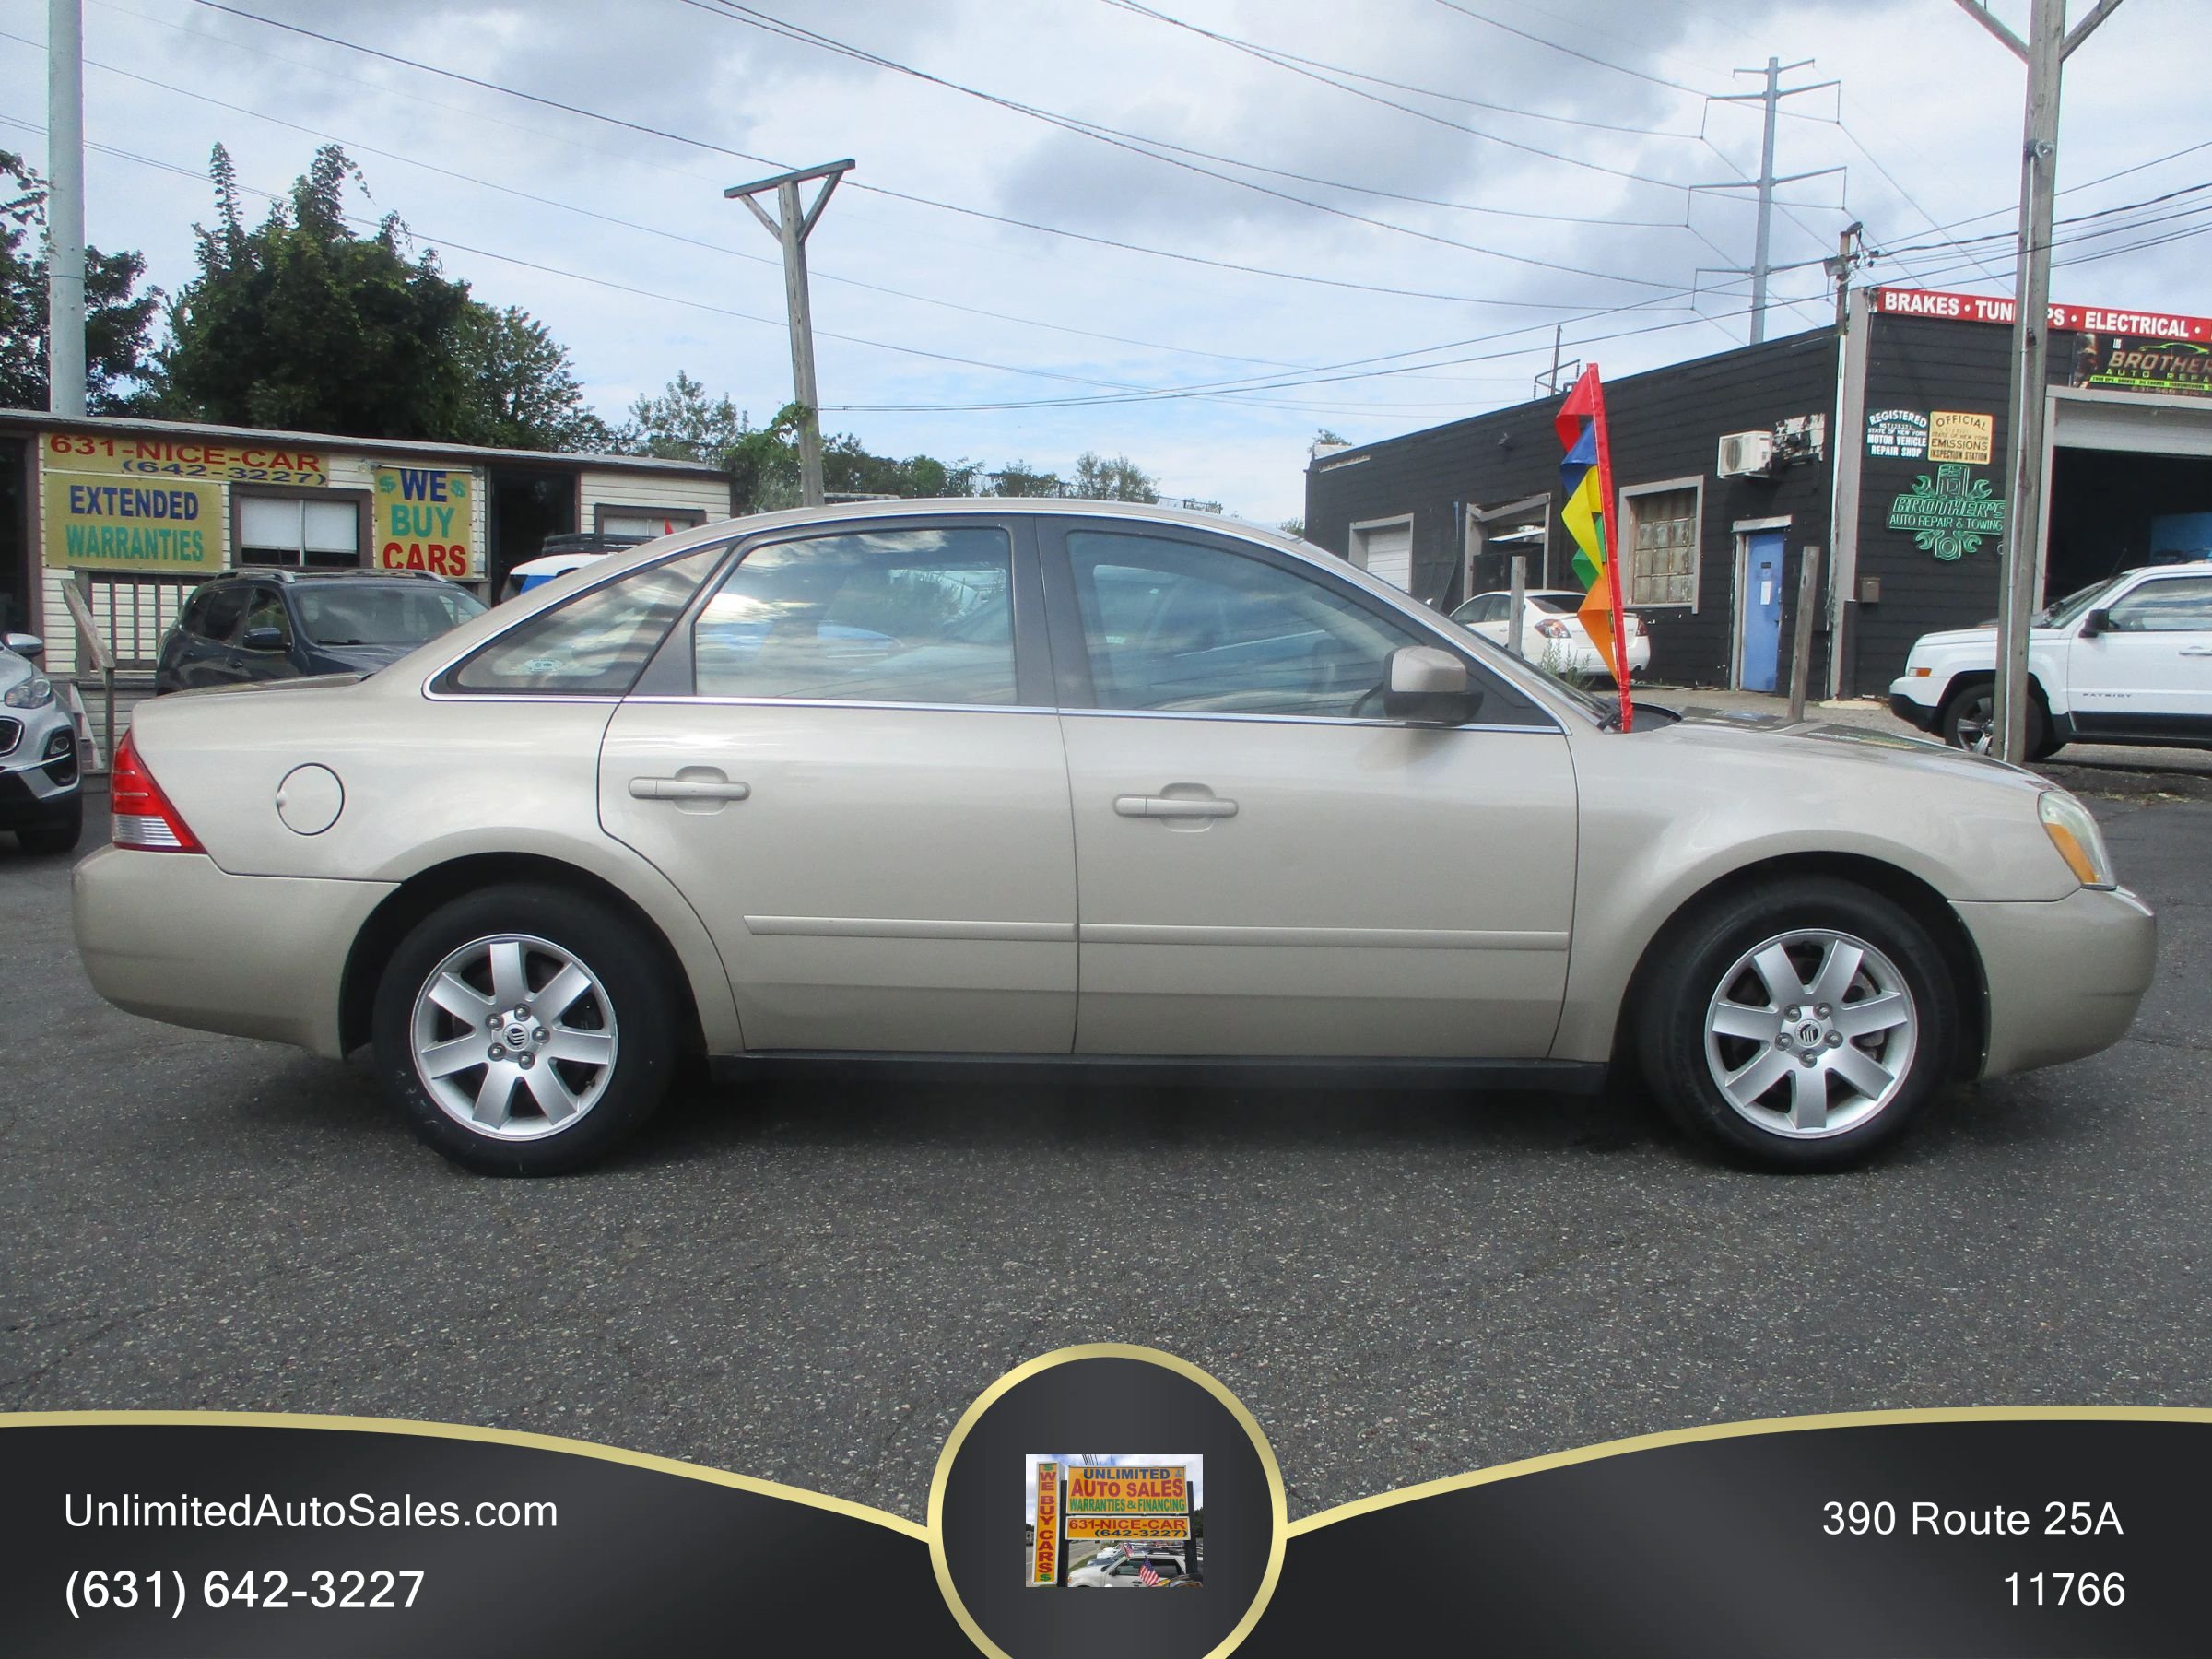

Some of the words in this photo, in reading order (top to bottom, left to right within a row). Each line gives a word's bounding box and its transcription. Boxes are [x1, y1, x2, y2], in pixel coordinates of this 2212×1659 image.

[1885, 291, 1959, 315] BRAKES
[1975, 300, 2016, 322] TUN
[2085, 312, 2189, 337] ELECTRICAL
[2106, 368, 2150, 378] AUTO
[1869, 410, 1927, 428] REGISTERED
[1936, 415, 1986, 431] OFFICIAL
[1866, 434, 1893, 445] MOTOR
[1897, 436, 1927, 447] VEHICLE
[1871, 445, 1899, 456] REPAIR
[1901, 447, 1922, 457] SHOP
[1931, 438, 1988, 451] EMISSIONS
[50, 435, 321, 473] 631-NICE-CAR
[1931, 449, 1962, 459] INSPECTION
[1964, 451, 1987, 461] STATION
[121, 459, 327, 486] (642-3227)
[398, 468, 448, 502] WE
[69, 485, 199, 521] EXTENDED
[1893, 497, 2006, 519] BROTHER'S
[391, 503, 455, 538] BUY
[1889, 514, 1916, 526] AUTO
[1918, 515, 1953, 528] REPAIR
[1956, 518, 1963, 529] &
[1966, 518, 2004, 531] TOWING
[65, 524, 205, 561] WARRANTIES
[382, 542, 466, 577] CARS
